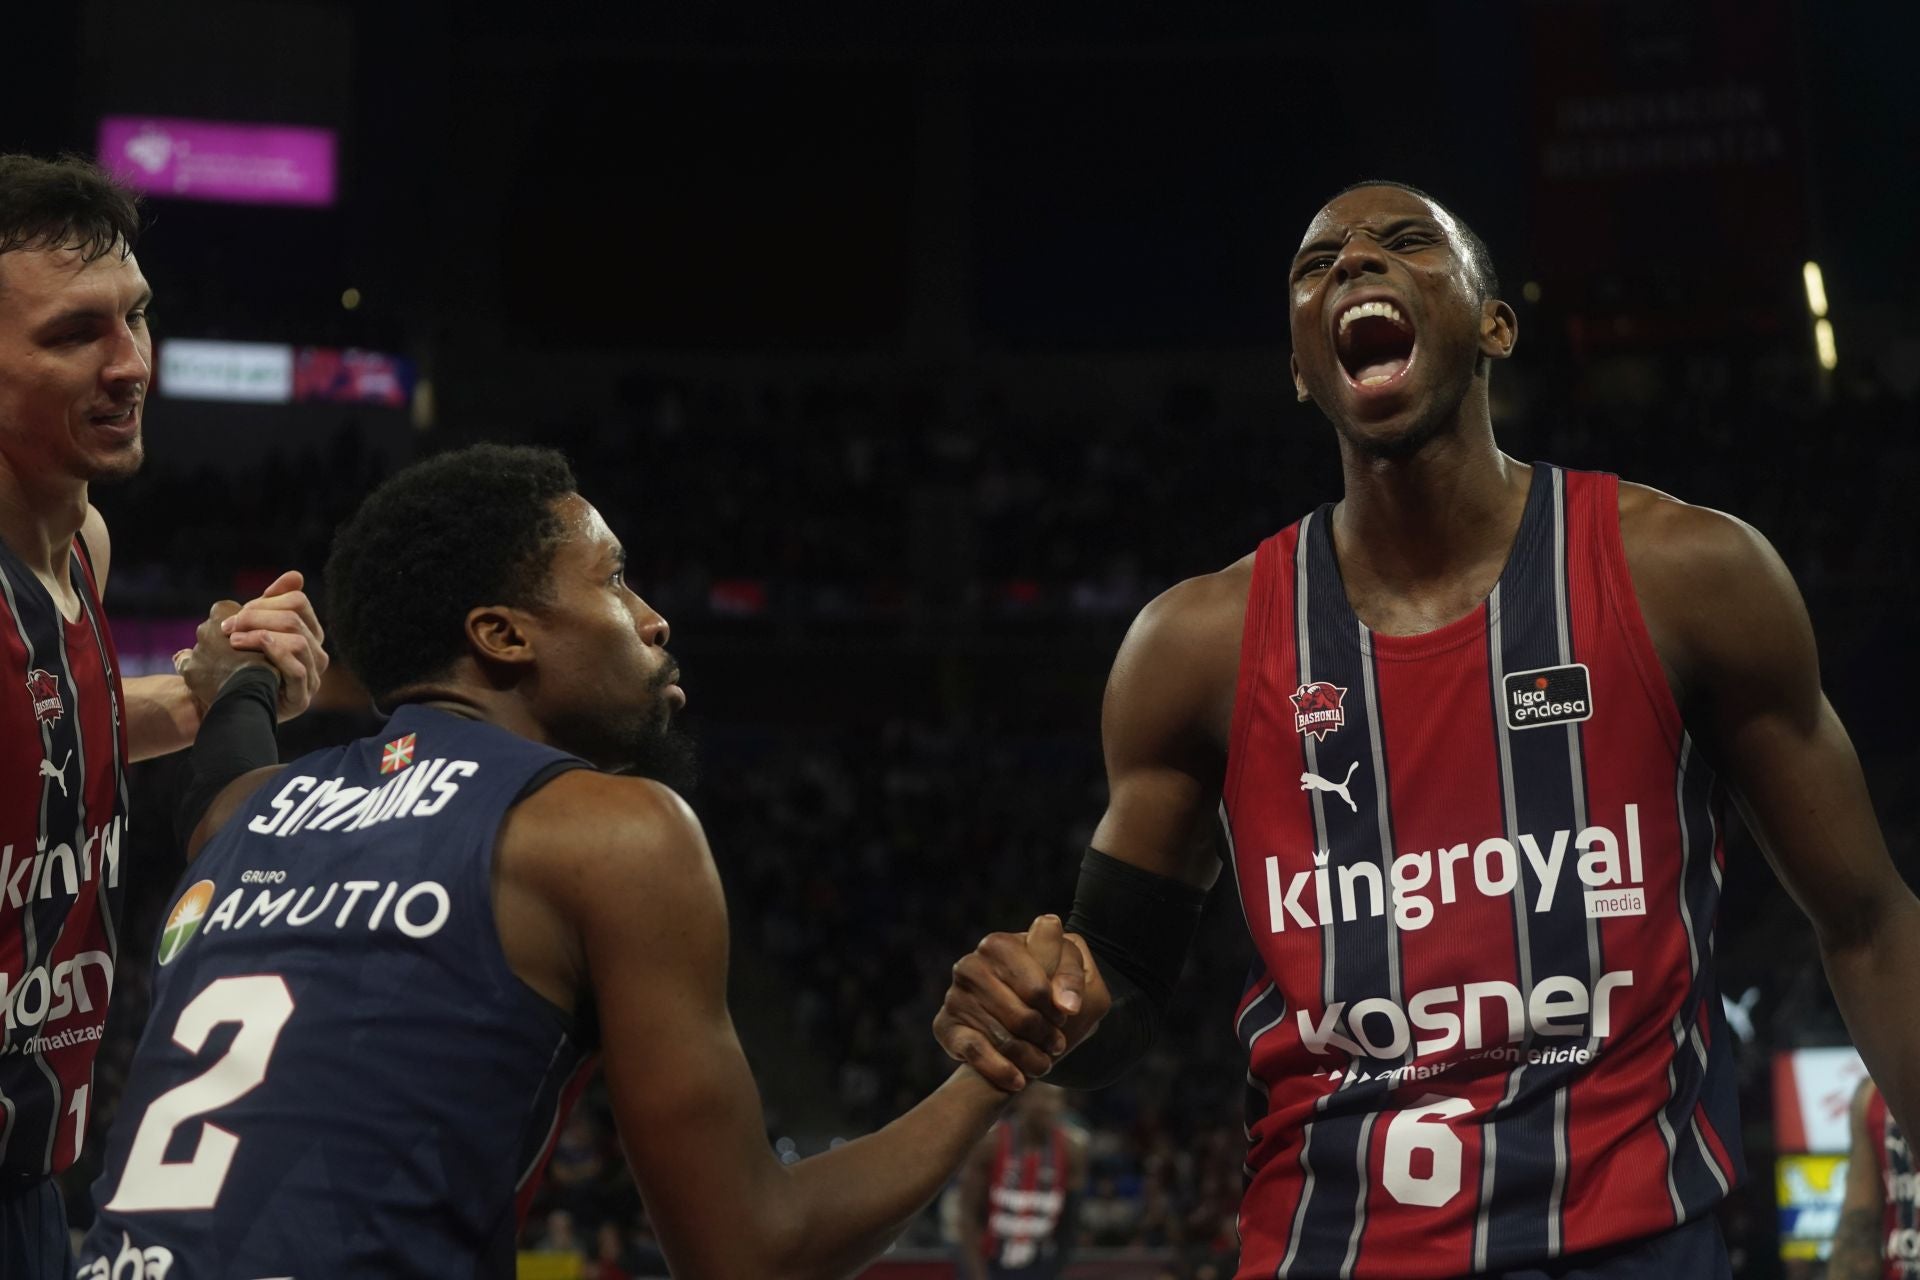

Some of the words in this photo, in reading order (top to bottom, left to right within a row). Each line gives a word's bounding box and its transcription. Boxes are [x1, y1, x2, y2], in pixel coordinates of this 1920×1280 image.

[1513, 689, 1545, 706] liga
[1298, 709, 1341, 727] BASKONIA
[1515, 700, 1585, 720] endesa
[240, 869, 287, 884] GRUPO
[1265, 803, 1644, 933] kingroyal
[202, 880, 450, 939] AMUTIO
[1527, 1045, 1600, 1065] eficie
[104, 975, 295, 1212] 2
[1382, 1093, 1476, 1208] 6
